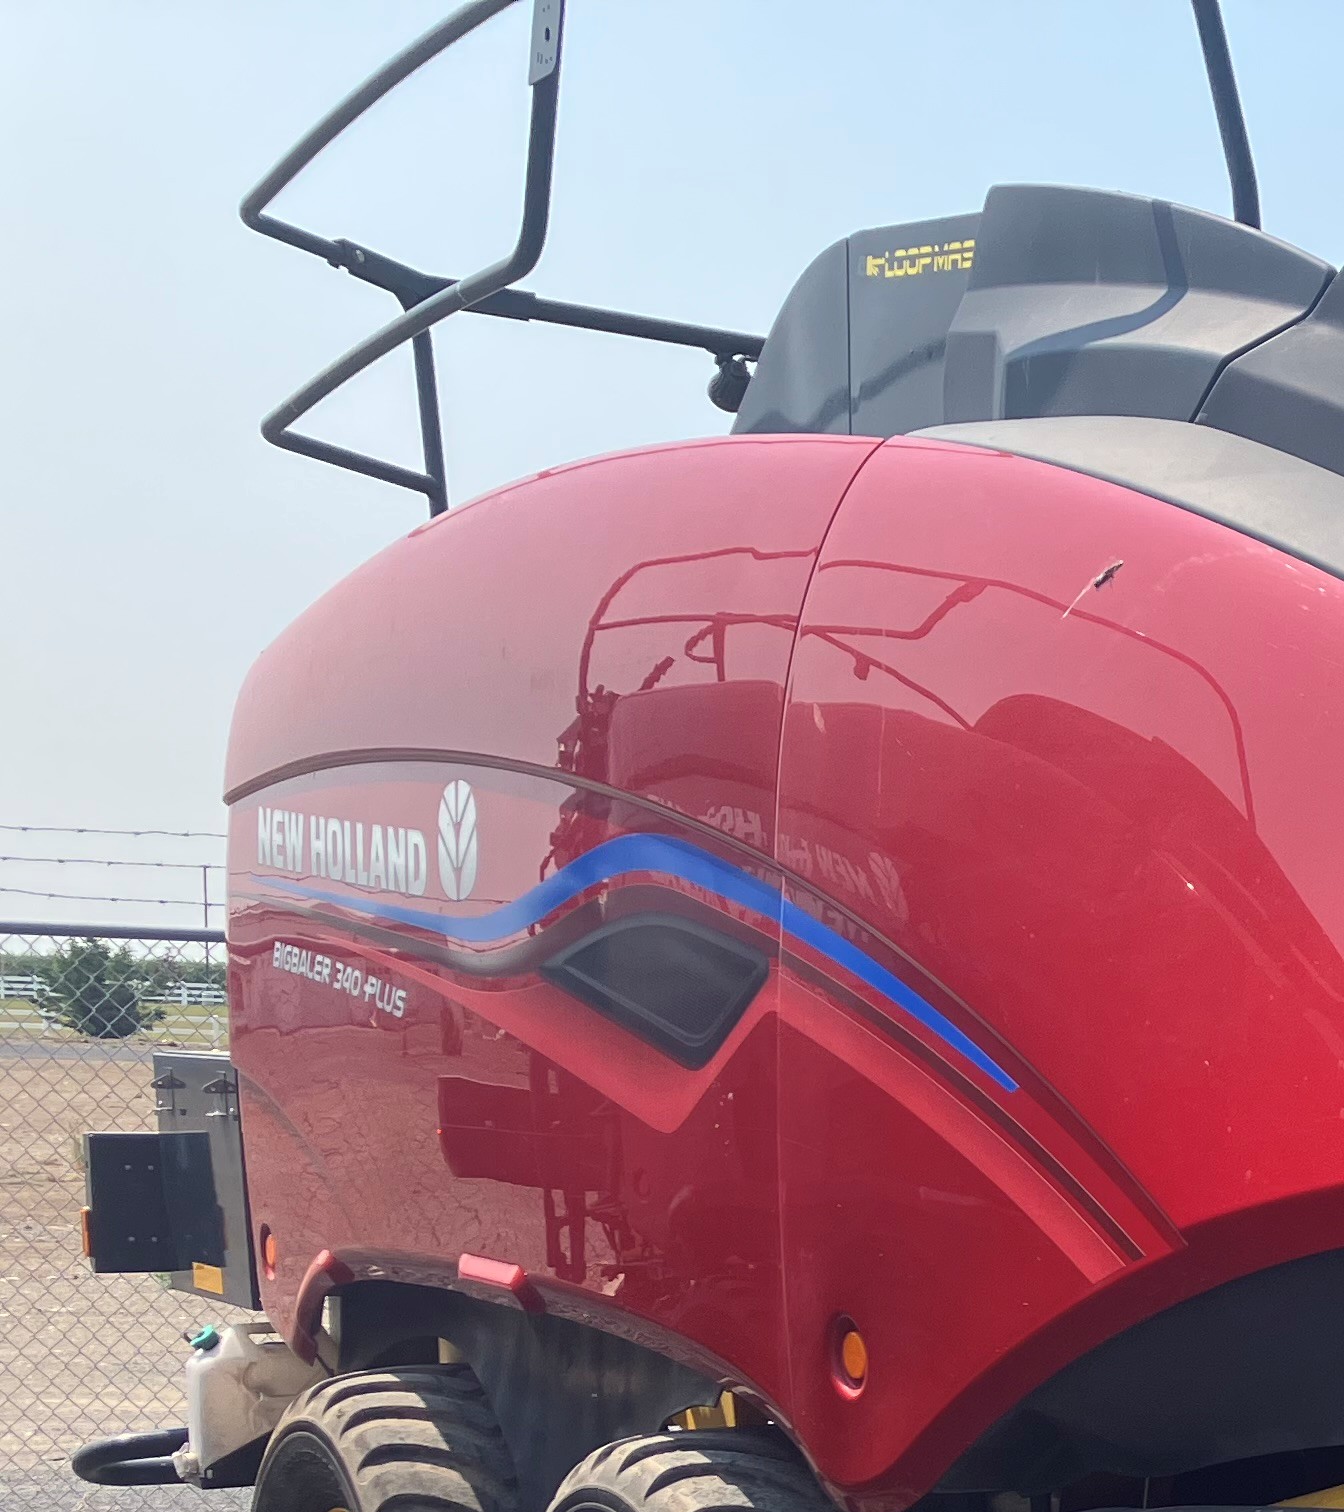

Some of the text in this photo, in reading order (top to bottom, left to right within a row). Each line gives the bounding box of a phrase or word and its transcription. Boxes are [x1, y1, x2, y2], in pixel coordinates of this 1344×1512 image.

[257, 806, 428, 897] NEW HOLLAND
[272, 941, 408, 1018] BIGBALER 340 PLUS
